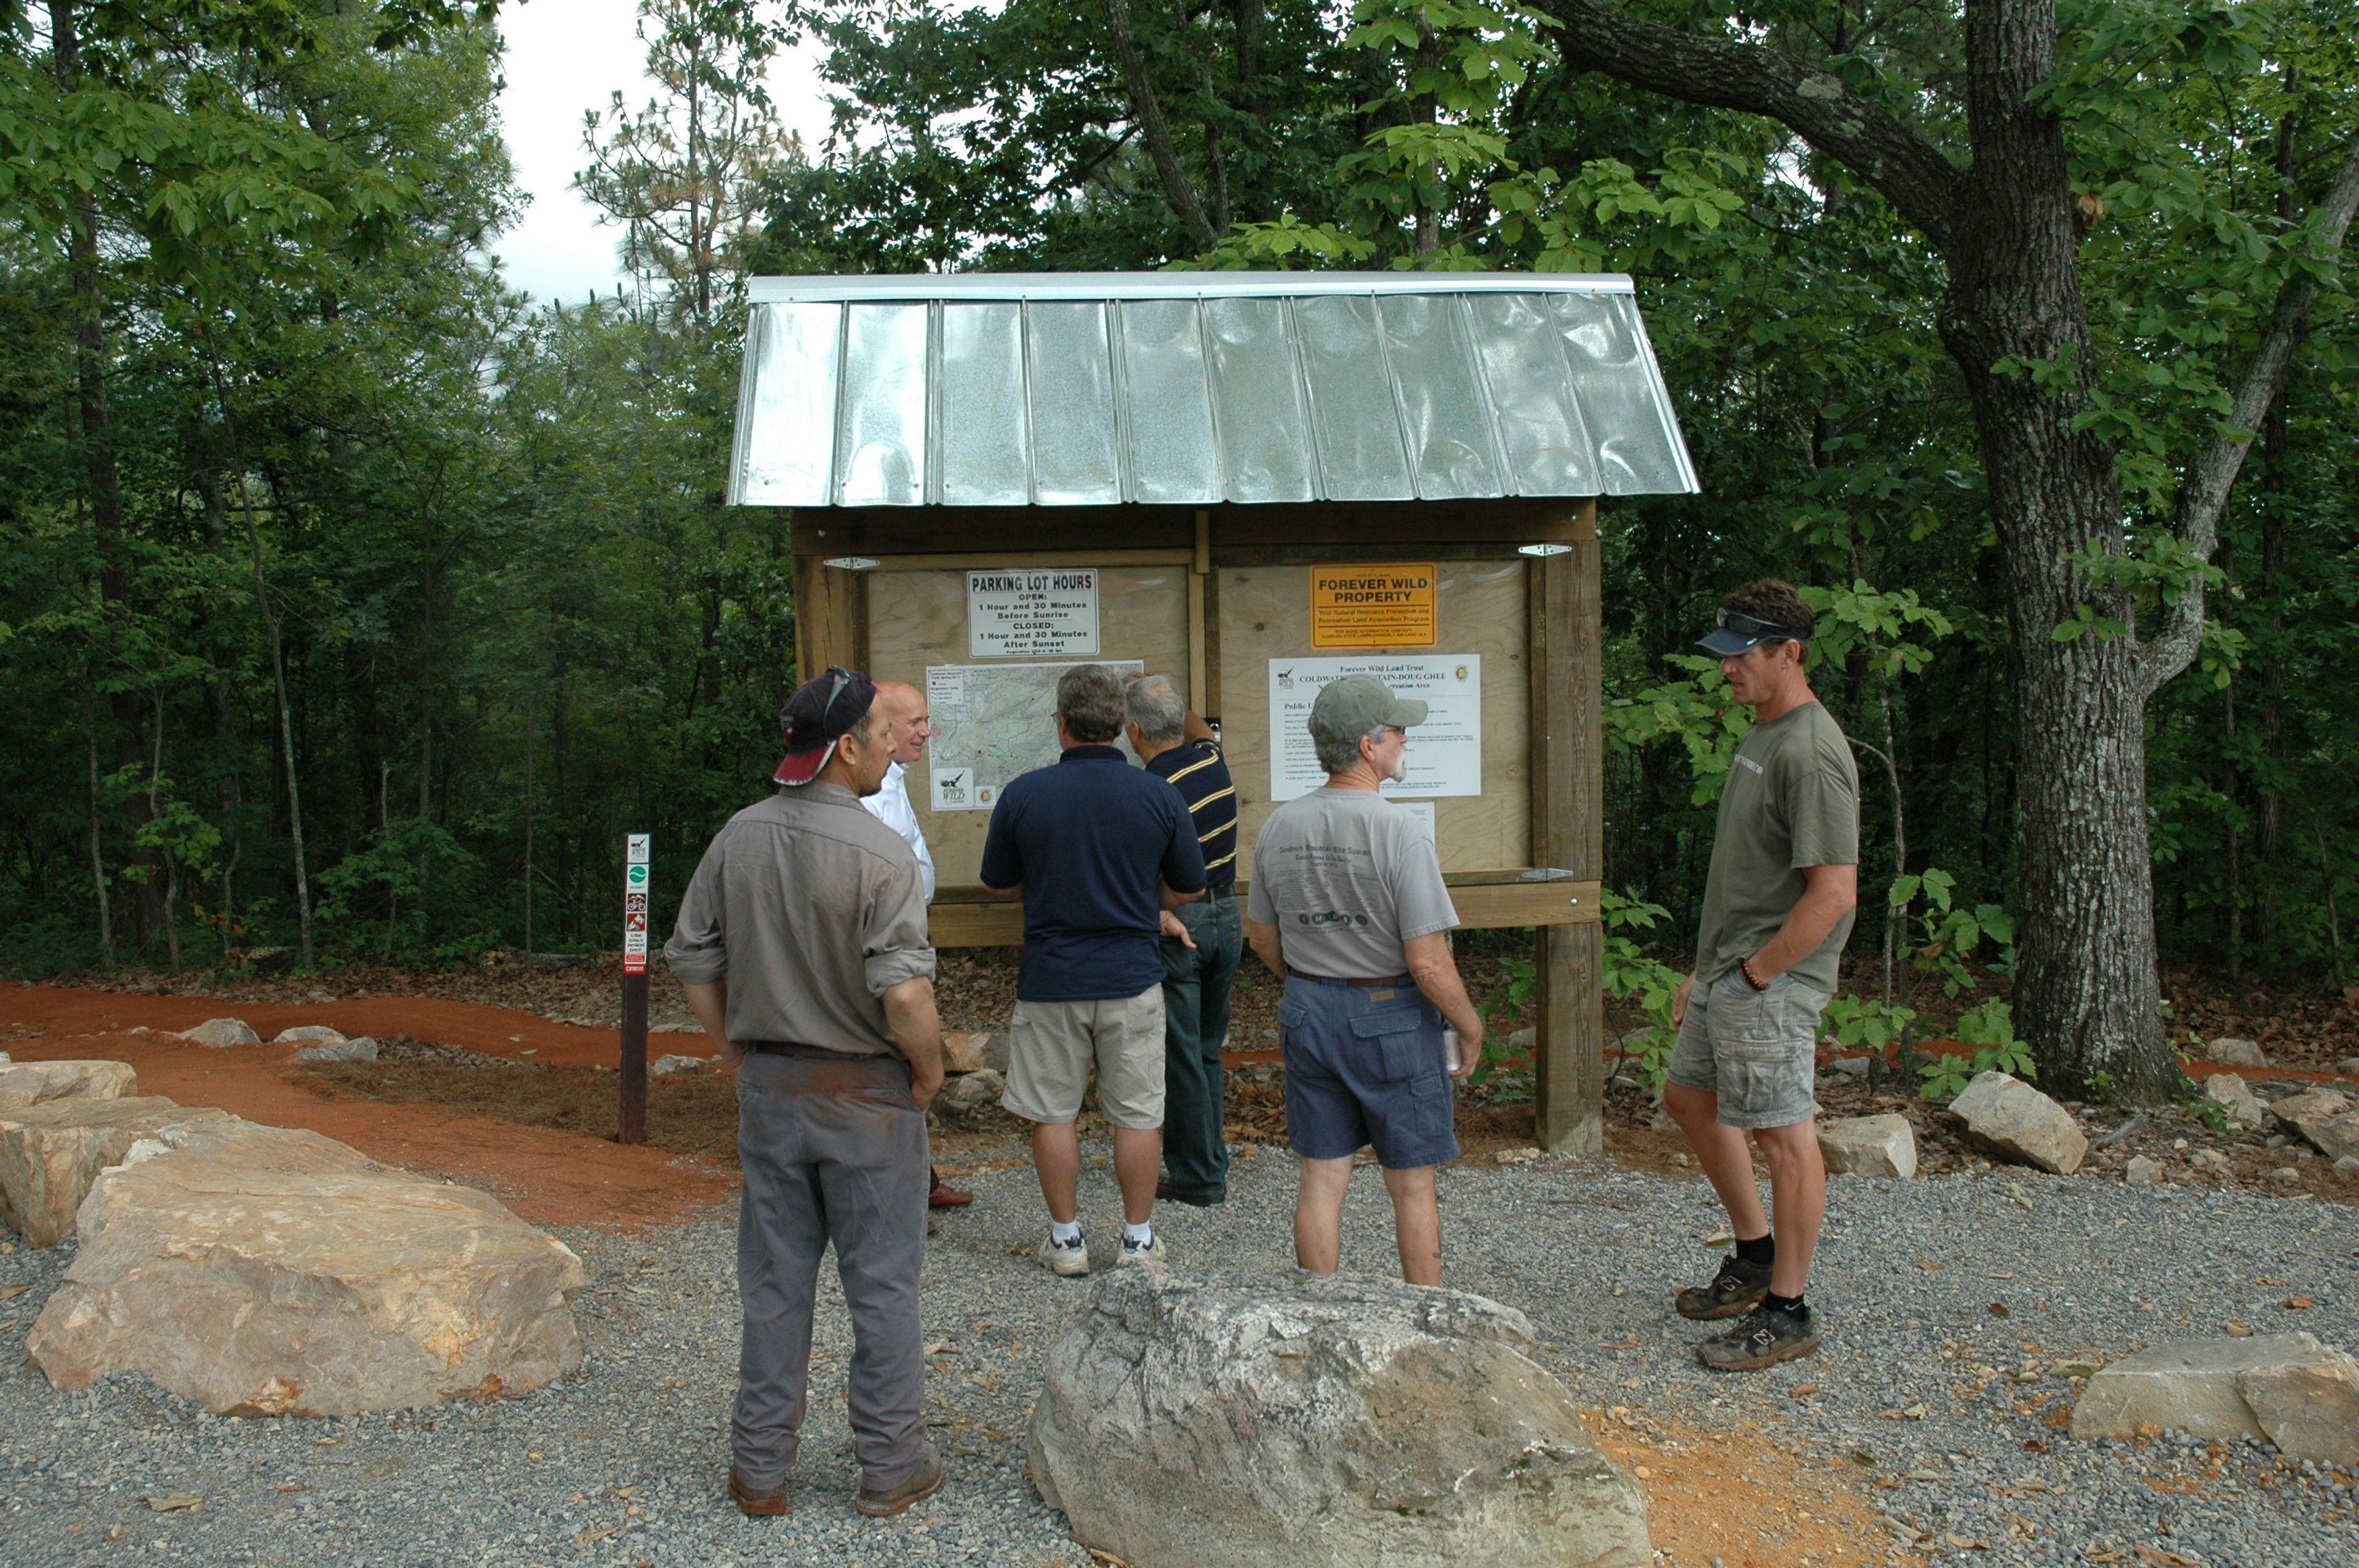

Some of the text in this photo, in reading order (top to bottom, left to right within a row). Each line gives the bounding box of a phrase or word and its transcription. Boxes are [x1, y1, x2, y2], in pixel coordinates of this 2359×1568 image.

[972, 574, 1092, 592] PARKING LOT HOURS
[1319, 577, 1427, 590] FOREVER WILD
[1334, 591, 1412, 603] PROPERTY
